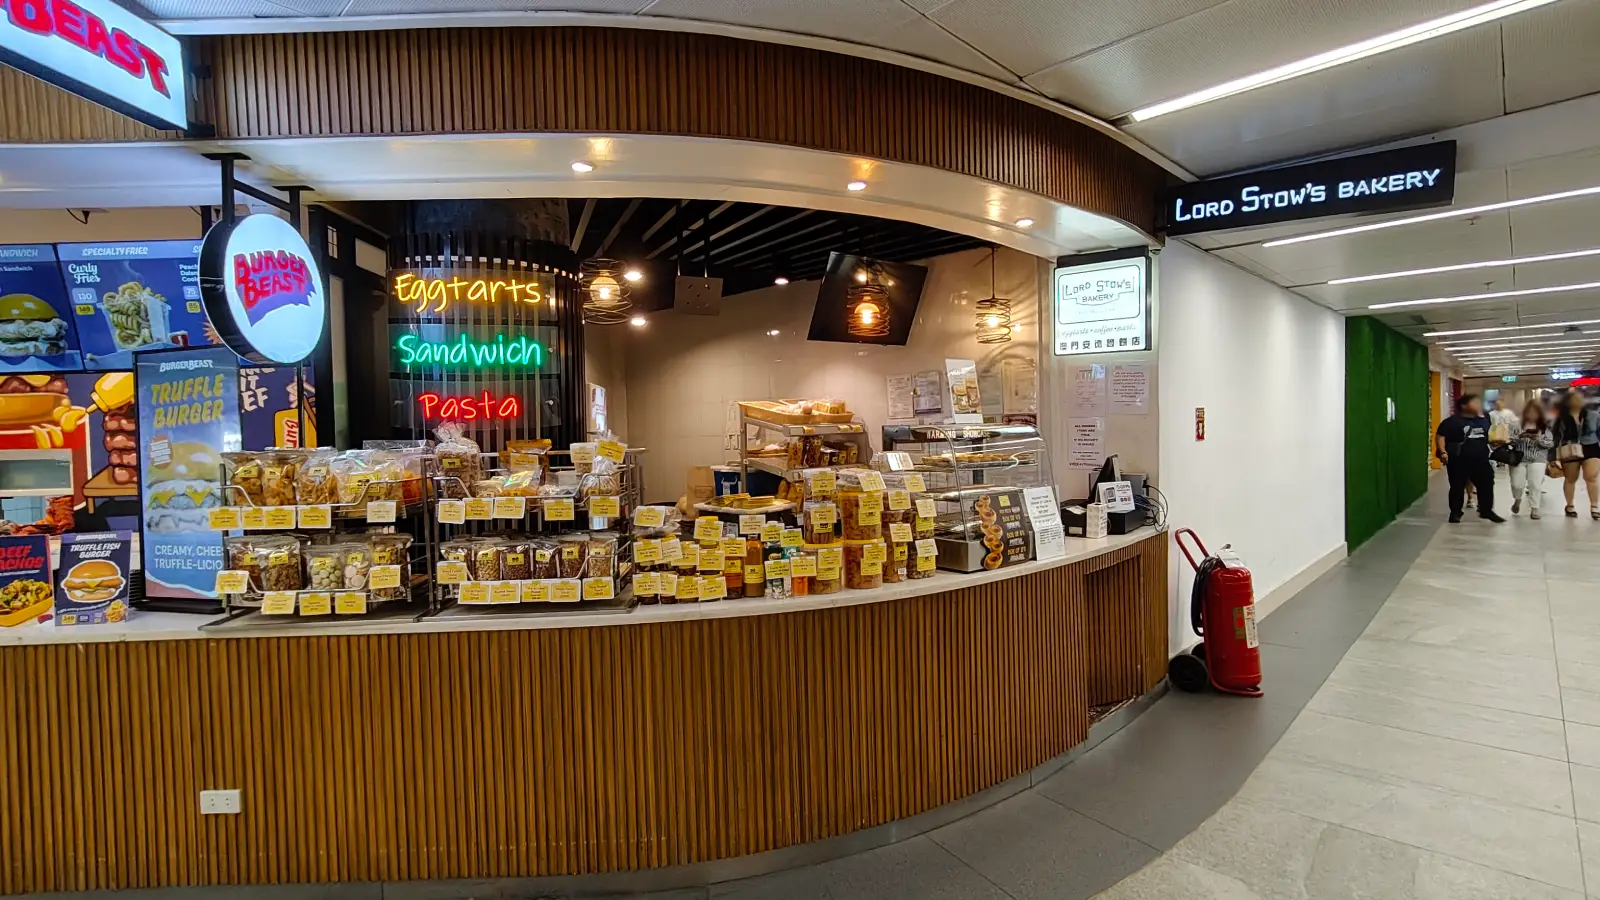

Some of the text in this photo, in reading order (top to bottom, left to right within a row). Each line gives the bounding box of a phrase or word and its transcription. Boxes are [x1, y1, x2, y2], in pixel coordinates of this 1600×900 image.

[1176, 168, 1441, 221] LORD STOW'S BAKERY
[81, 246, 149, 256] SPECIALTY FRIES
[68, 263, 98, 275] Curly
[73, 272, 101, 284] Fries
[233, 249, 307, 285] BURGER
[243, 271, 306, 312] BEAST
[394, 272, 542, 313] Eggtarts
[1065, 281, 1092, 296] LORD
[1081, 293, 1114, 303] BAKERY
[397, 332, 542, 367] Sandwich
[151, 373, 225, 407] TRUFFLE
[153, 398, 225, 429] BURGER
[417, 389, 519, 420] Pasta
[70, 542, 122, 552] TRUFFLE FISH
[78, 550, 112, 559] BURGER
[154, 544, 196, 557] CREAMY,
